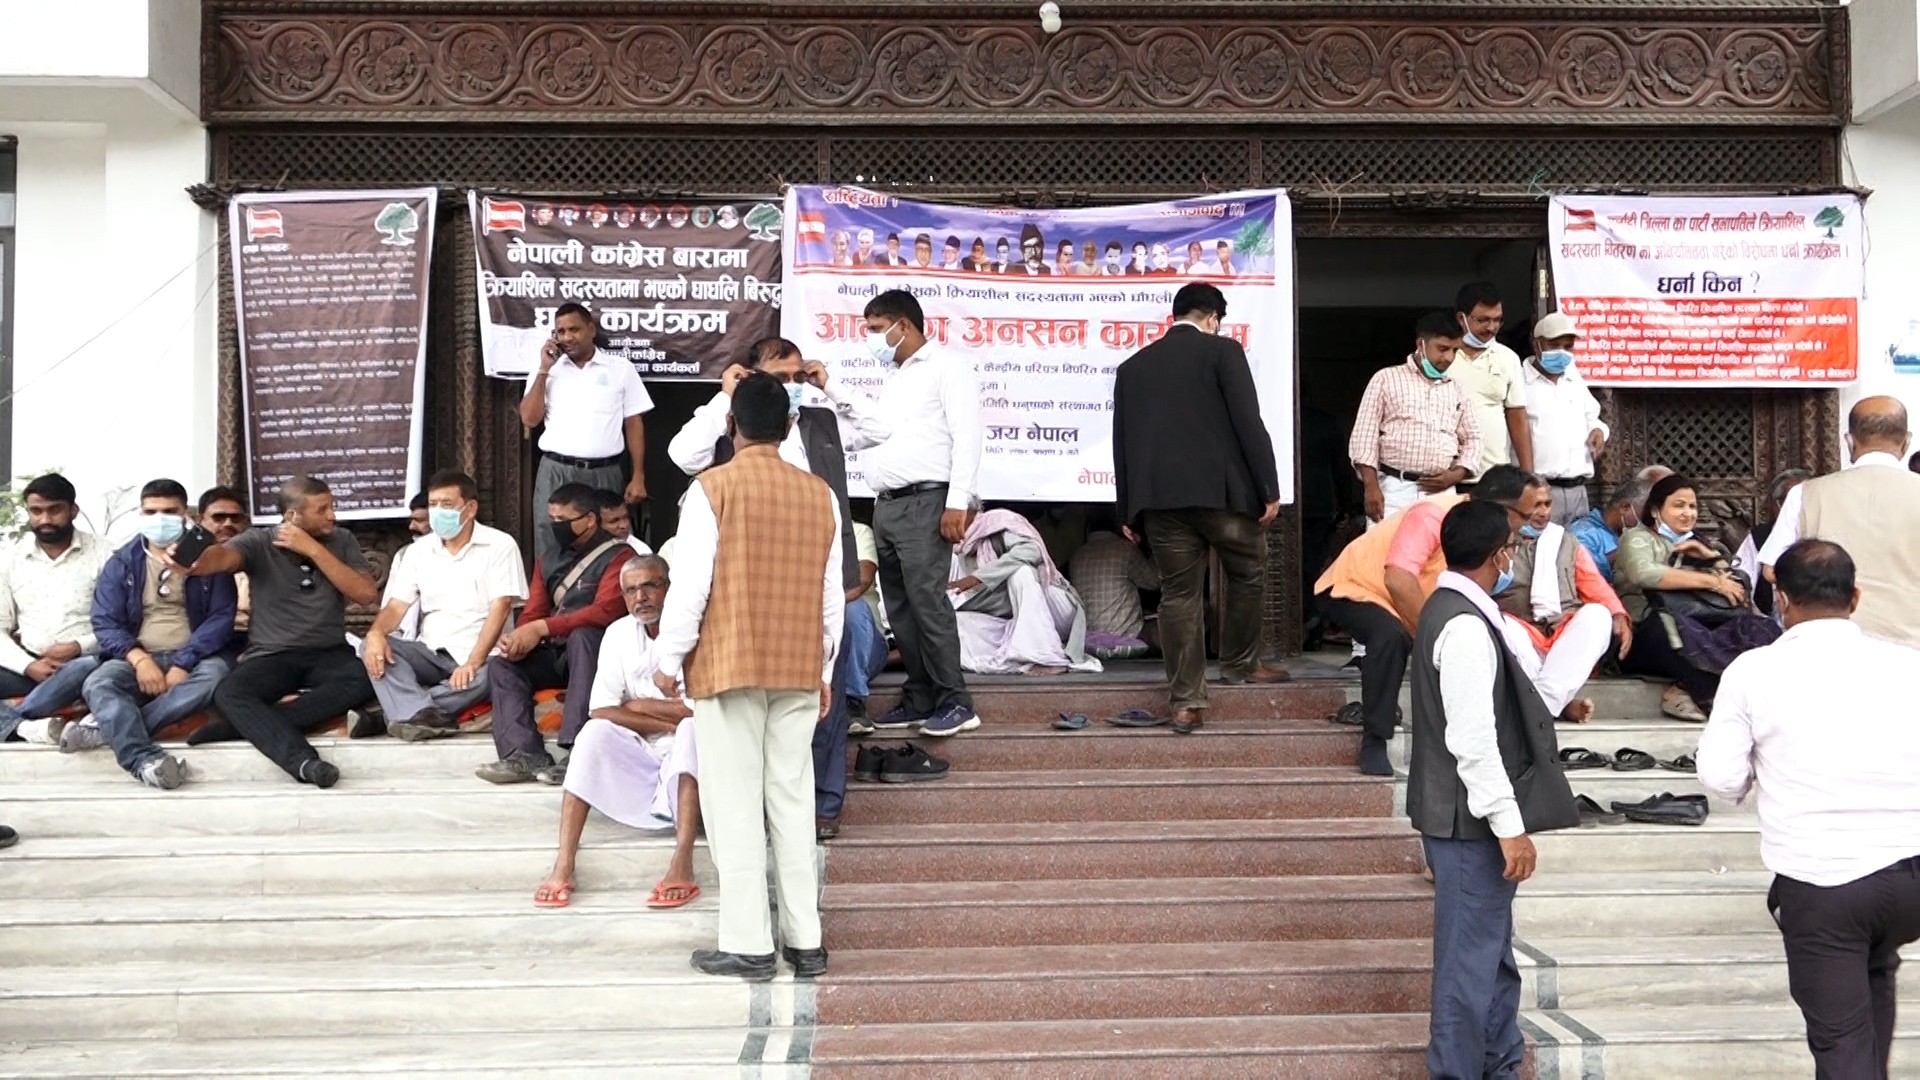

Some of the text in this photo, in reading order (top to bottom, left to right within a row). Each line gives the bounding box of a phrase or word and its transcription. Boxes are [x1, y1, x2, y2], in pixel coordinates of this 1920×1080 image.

[507, 237, 749, 269] नेपाली कांग्रेस बारामा
[559, 277, 640, 299] सदस्यतामा
[644, 274, 688, 300] भएको
[838, 282, 878, 297] नेपाली
[1657, 272, 1695, 293] धर्ना
[1702, 270, 1742, 293] किन
[600, 303, 729, 334] कार्यक्रम
[962, 317, 1088, 347] अनसन
[986, 422, 1080, 442] जय नेपाल
